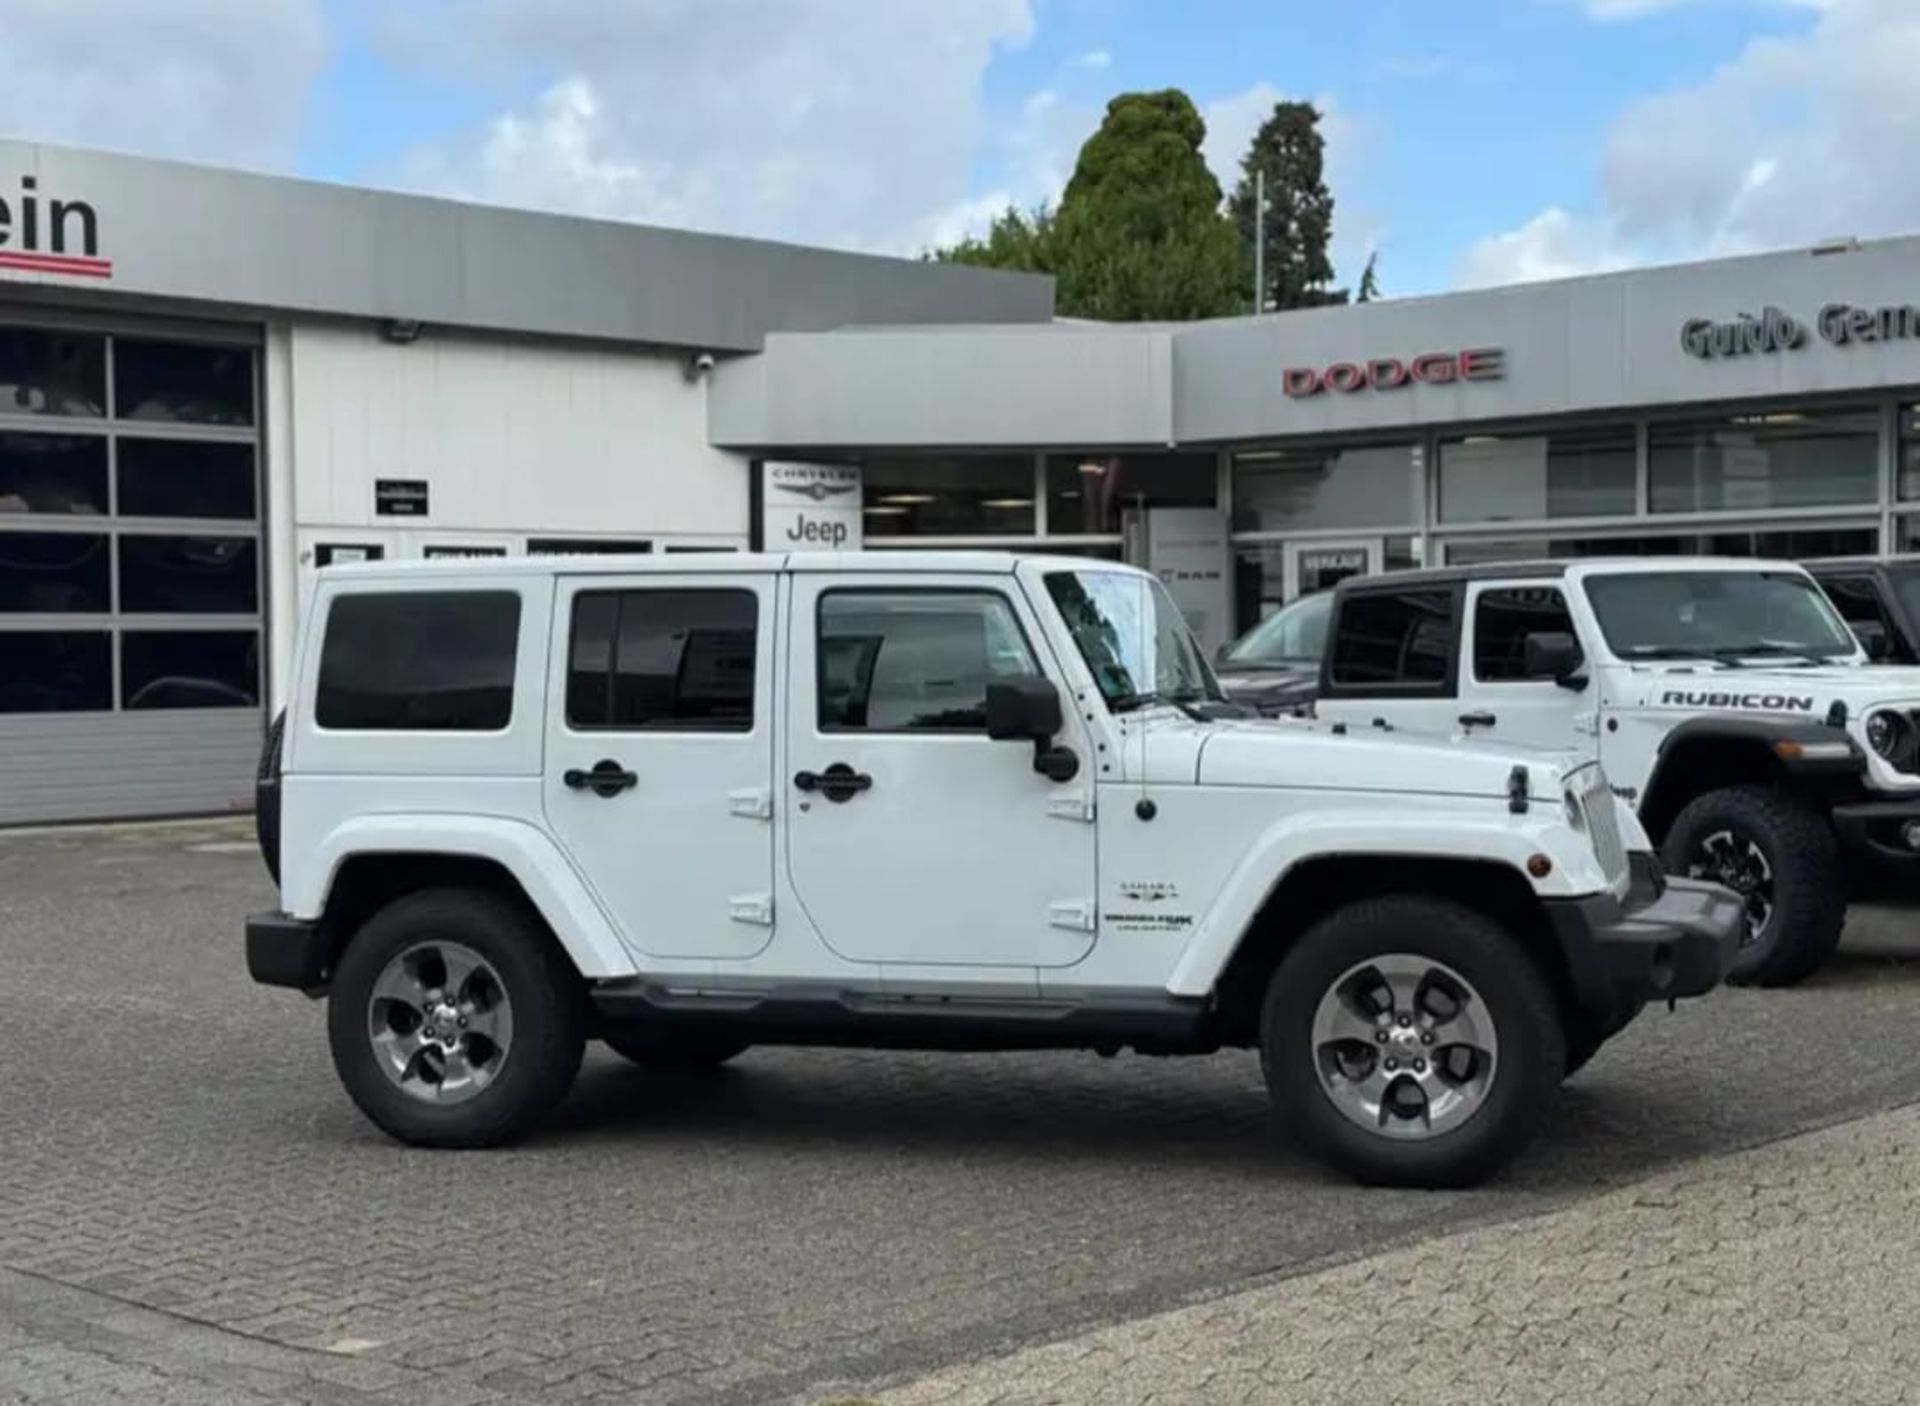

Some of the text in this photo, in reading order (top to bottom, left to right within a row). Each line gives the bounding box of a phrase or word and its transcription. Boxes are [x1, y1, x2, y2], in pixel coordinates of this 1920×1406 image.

[0, 175, 97, 256] in
[1681, 306, 1806, 358] Guido
[1283, 349, 1505, 397] DODGE
[787, 513, 847, 548] Jeep
[1662, 691, 1813, 711] RUBICON
